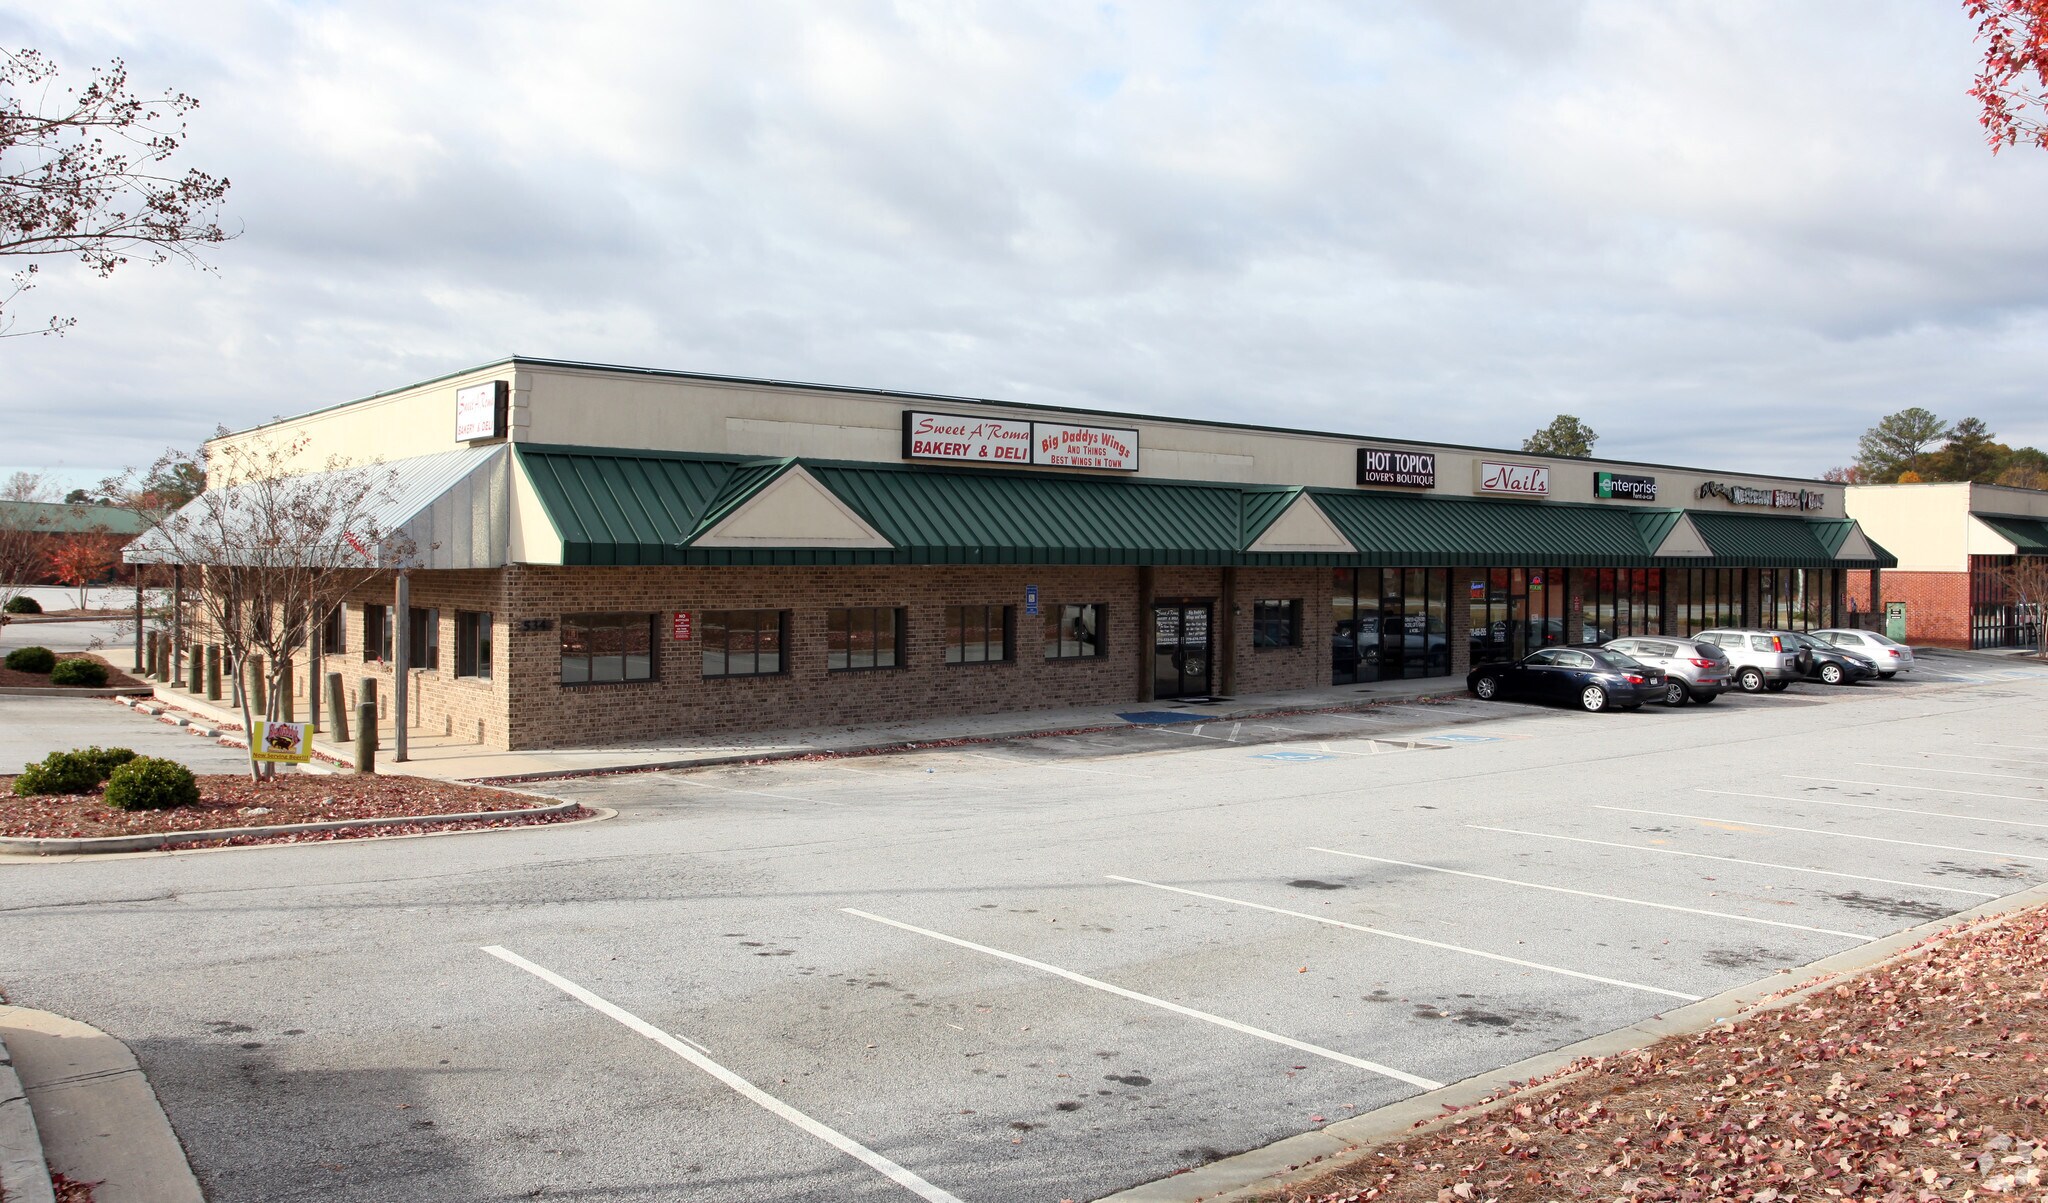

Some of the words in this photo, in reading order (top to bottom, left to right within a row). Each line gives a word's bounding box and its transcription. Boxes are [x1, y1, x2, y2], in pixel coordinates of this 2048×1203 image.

[914, 418, 965, 436] Sweet
[967, 423, 1029, 440] A'Roma
[913, 440, 971, 456] BAKERY
[978, 445, 988, 457] &
[994, 446, 1027, 460] DELI
[1041, 435, 1059, 453] Big
[1062, 429, 1098, 446] Daddys
[1101, 432, 1130, 458] Wings
[1067, 445, 1080, 454] AND
[1083, 446, 1106, 456] THINGS
[1051, 455, 1068, 464] BEST
[1071, 456, 1092, 466] WINGS
[1104, 458, 1121, 468] TOWN
[1366, 451, 1391, 471] HOT
[1394, 453, 1433, 474] TOPICX
[1366, 471, 1394, 482] LOVER'S
[1396, 473, 1433, 486] BOUTIQUE
[1484, 467, 1546, 491] Nails
[1599, 479, 1658, 498] enterprise
[523, 619, 546, 631] 534
